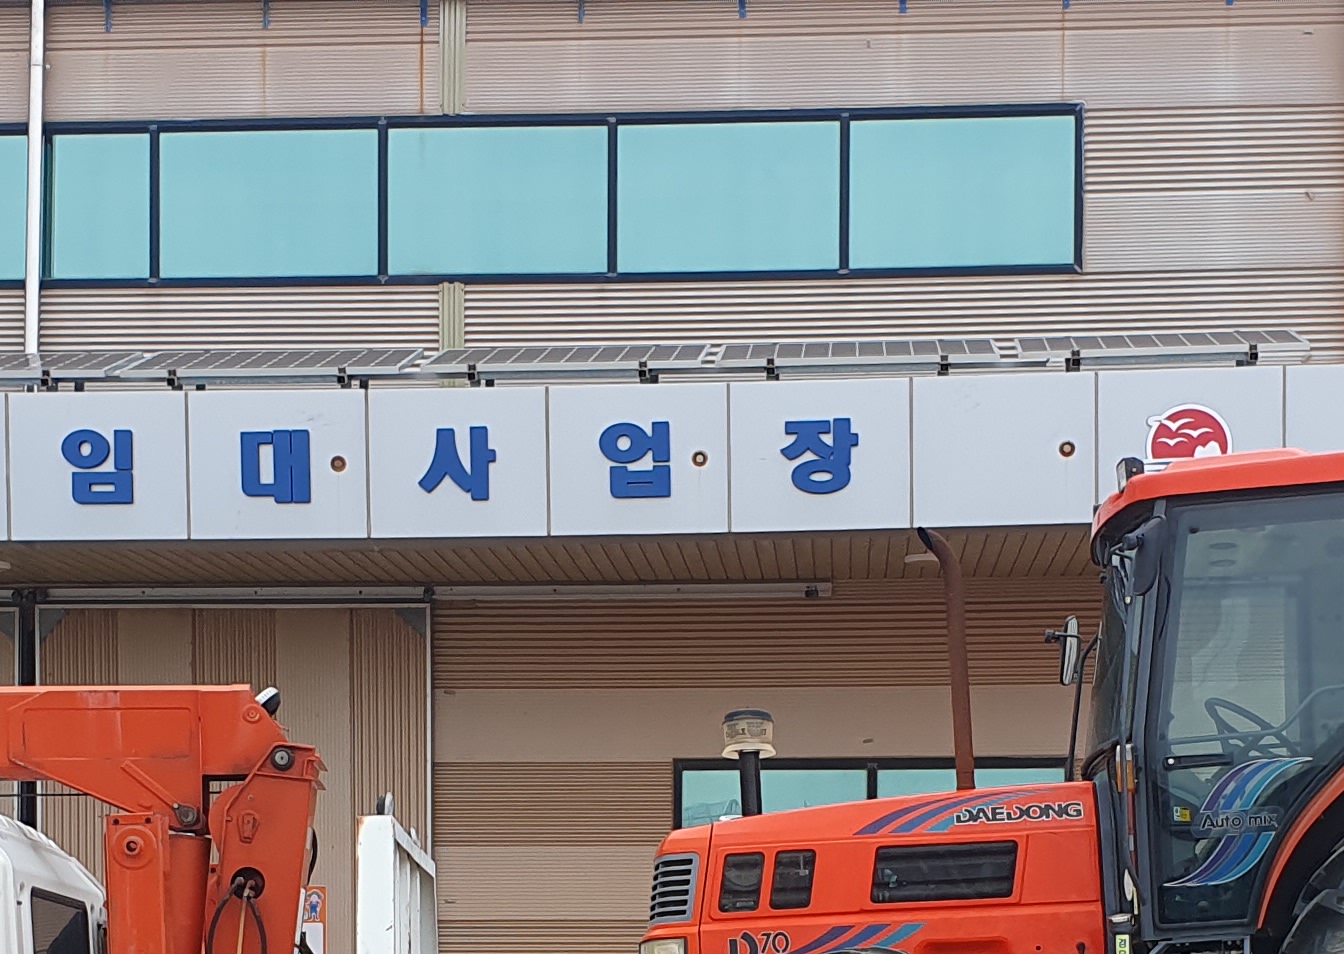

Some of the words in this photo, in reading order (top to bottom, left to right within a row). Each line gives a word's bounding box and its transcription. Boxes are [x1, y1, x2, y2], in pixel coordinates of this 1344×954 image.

[954, 801, 1084, 825] DAEDONG
[1201, 813, 1242, 830] Auto
[1247, 813, 1278, 828] mix
